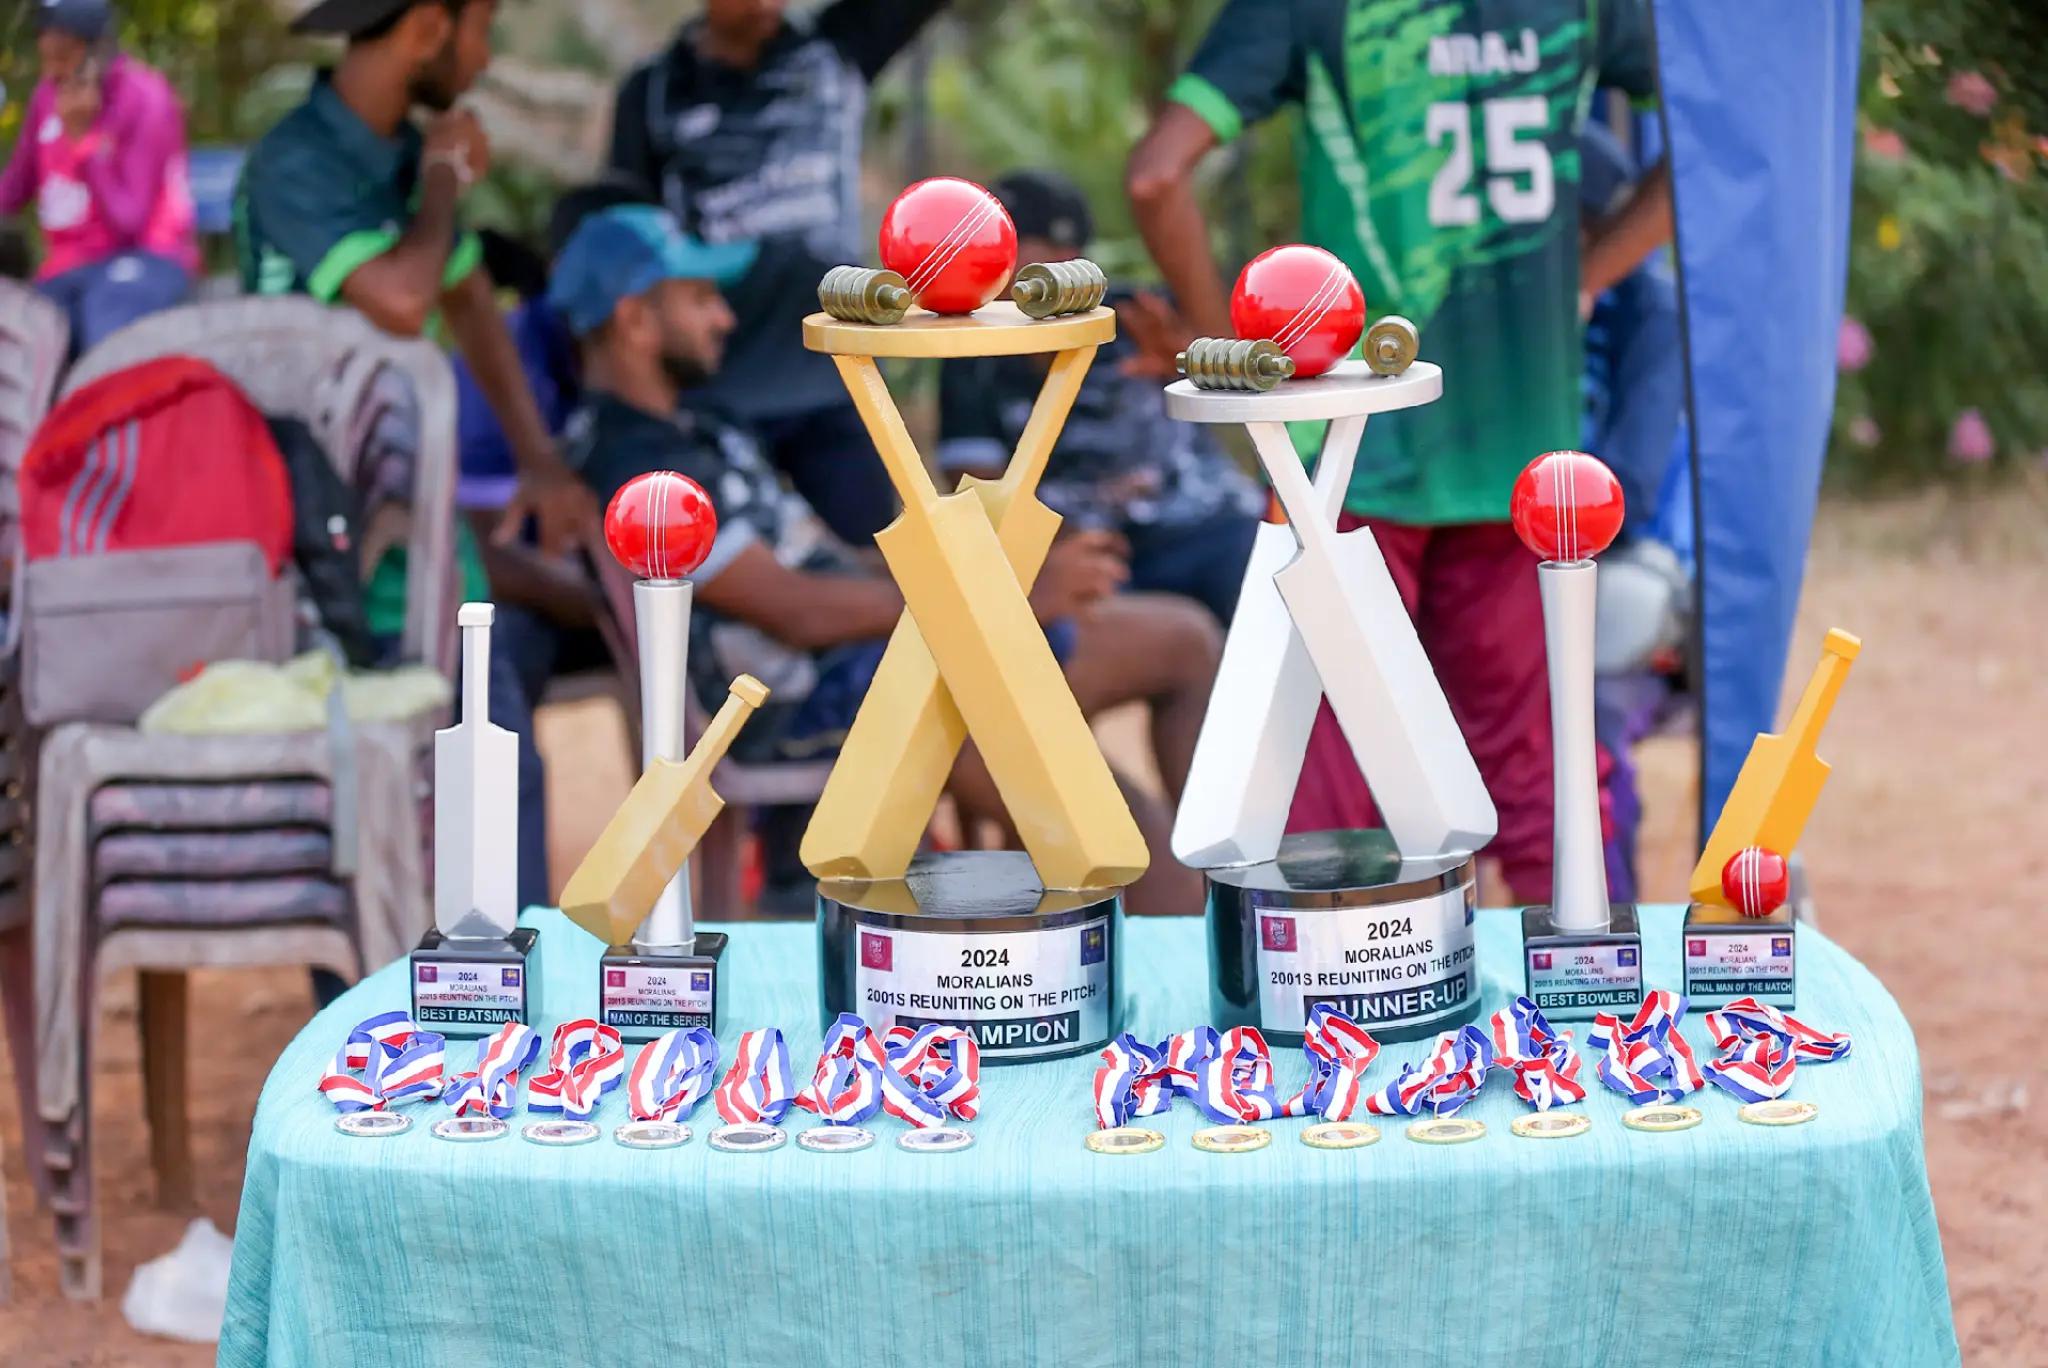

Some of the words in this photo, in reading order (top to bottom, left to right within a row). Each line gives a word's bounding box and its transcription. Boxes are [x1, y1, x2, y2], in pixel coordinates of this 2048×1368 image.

[1427, 95, 1554, 228] 25
[1367, 917, 1413, 940] 2024
[1344, 939, 1433, 964] MORALIANS
[1728, 944, 1748, 953] 2024
[961, 948, 1010, 968] 2024
[1271, 971, 1312, 986] 2001S
[1318, 966, 1402, 987] REUNITING
[1406, 962, 1427, 978] ON
[1431, 954, 1451, 972] THE
[1453, 944, 1475, 965] PITCH
[1574, 956, 1594, 965] 2024
[458, 972, 478, 981] 2024
[647, 977, 667, 986] 2024
[937, 973, 1033, 990] MORALIANS
[638, 988, 676, 996] MORALIANS
[1691, 983, 1714, 992] FINAL
[1716, 983, 1734, 992] MAN
[1736, 983, 1746, 991] OF
[1748, 982, 1763, 991] THE
[1765, 982, 1791, 991] MATCH
[474, 994, 483, 1002] ON
[675, 999, 686, 1007] THE
[867, 988, 905, 1007] 2001S
[910, 994, 996, 1010] REUNITING
[1001, 994, 1024, 1009] ON
[1029, 992, 1057, 1007] THE
[1061, 983, 1096, 1005] PITCH
[1318, 977, 1466, 1020] UNNER-UP
[1540, 994, 1575, 1007] BEST
[1578, 991, 1636, 1005] BOWLER
[420, 1008, 455, 1020] BEST
[458, 1009, 520, 1022] BATSMAN
[611, 1014, 632, 1025] MAN
[634, 1014, 649, 1025] OF
[650, 1014, 670, 1026] THE
[673, 1015, 708, 1027] SERIES
[950, 1018, 1070, 1046] AMPION
